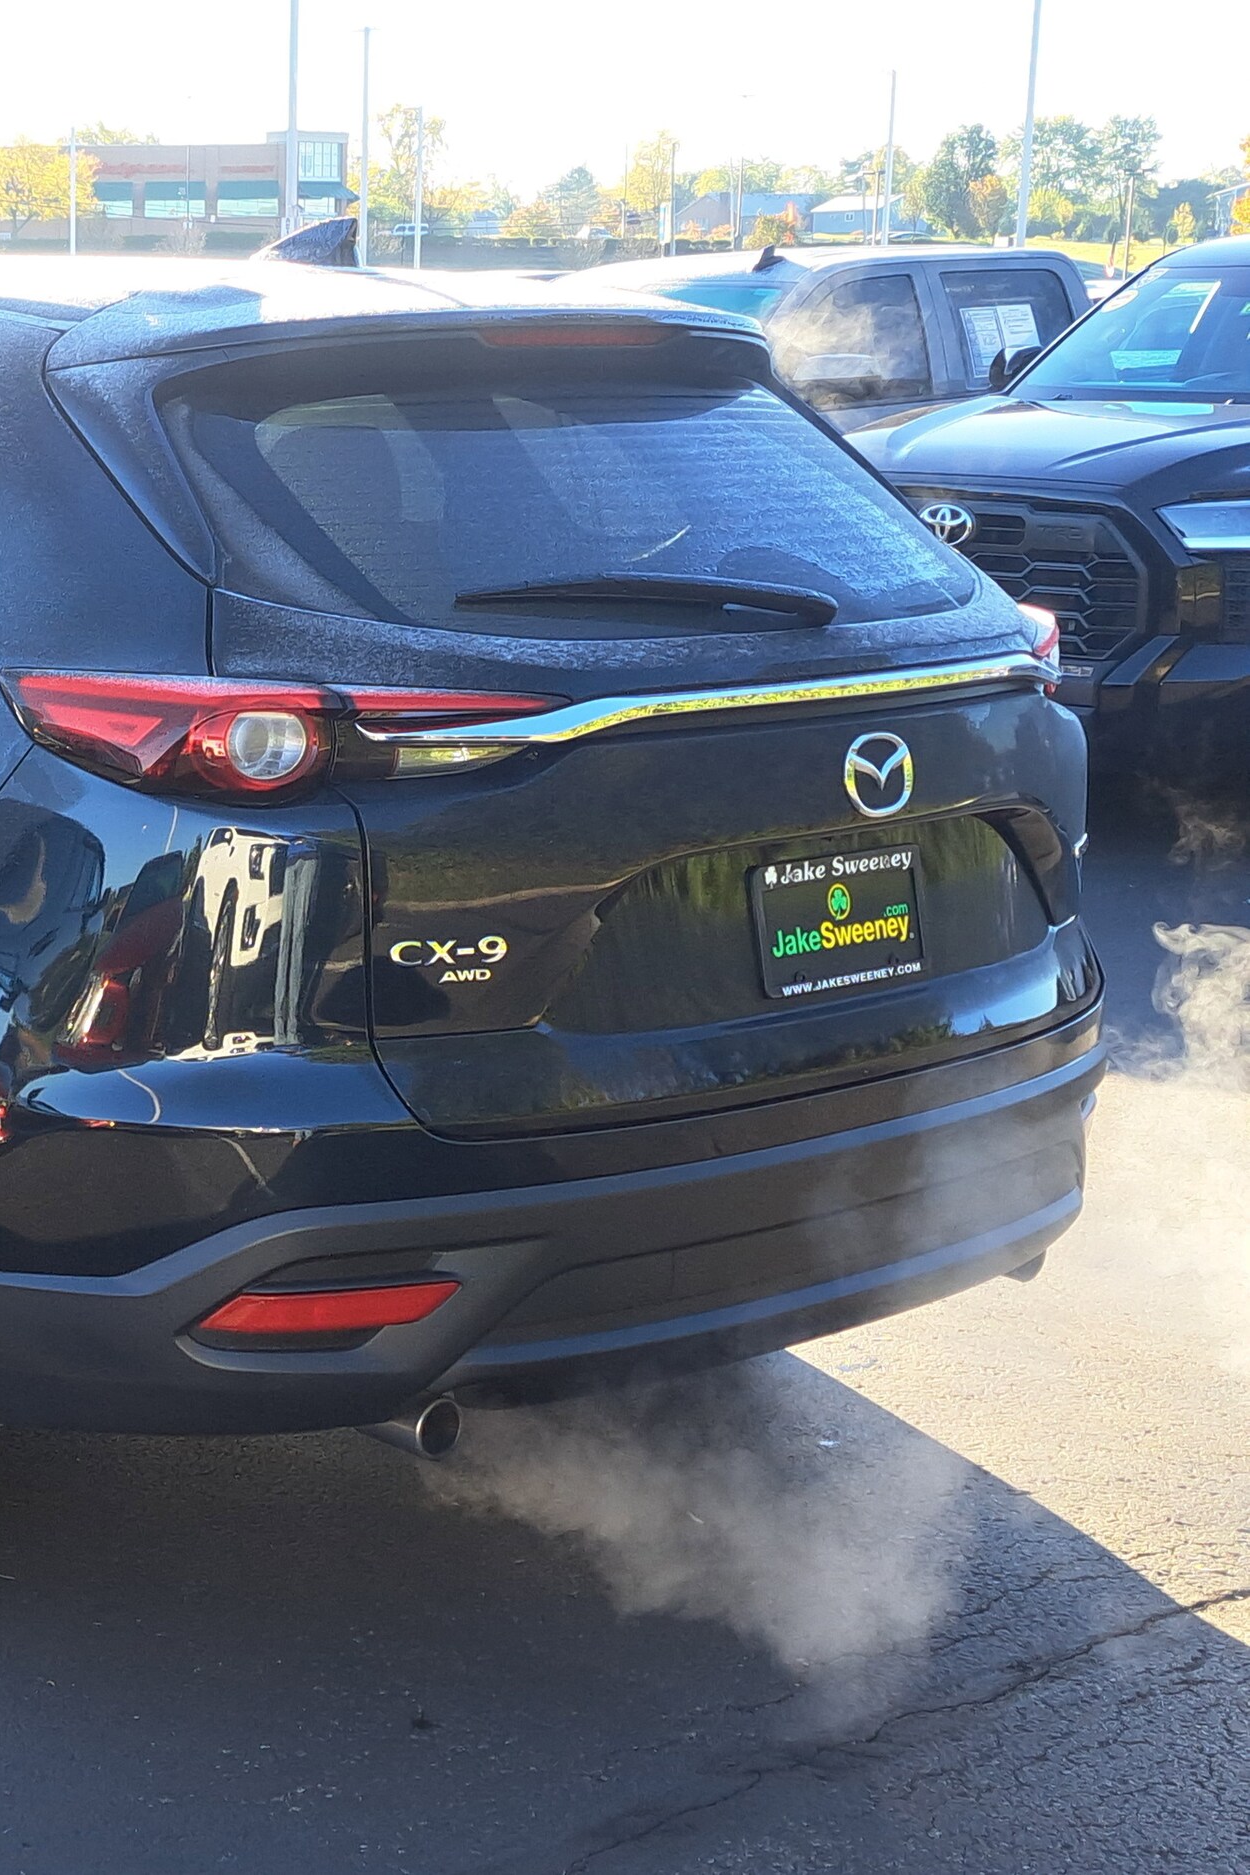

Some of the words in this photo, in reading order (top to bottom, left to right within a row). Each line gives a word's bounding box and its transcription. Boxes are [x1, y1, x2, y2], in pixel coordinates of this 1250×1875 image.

[781, 861, 826, 884] Jake
[831, 851, 912, 877] Sweeney
[390, 935, 508, 966] CX-9
[438, 968, 492, 984] AWD
[782, 962, 922, 996] WWW.JAKESWEENEY.COM
